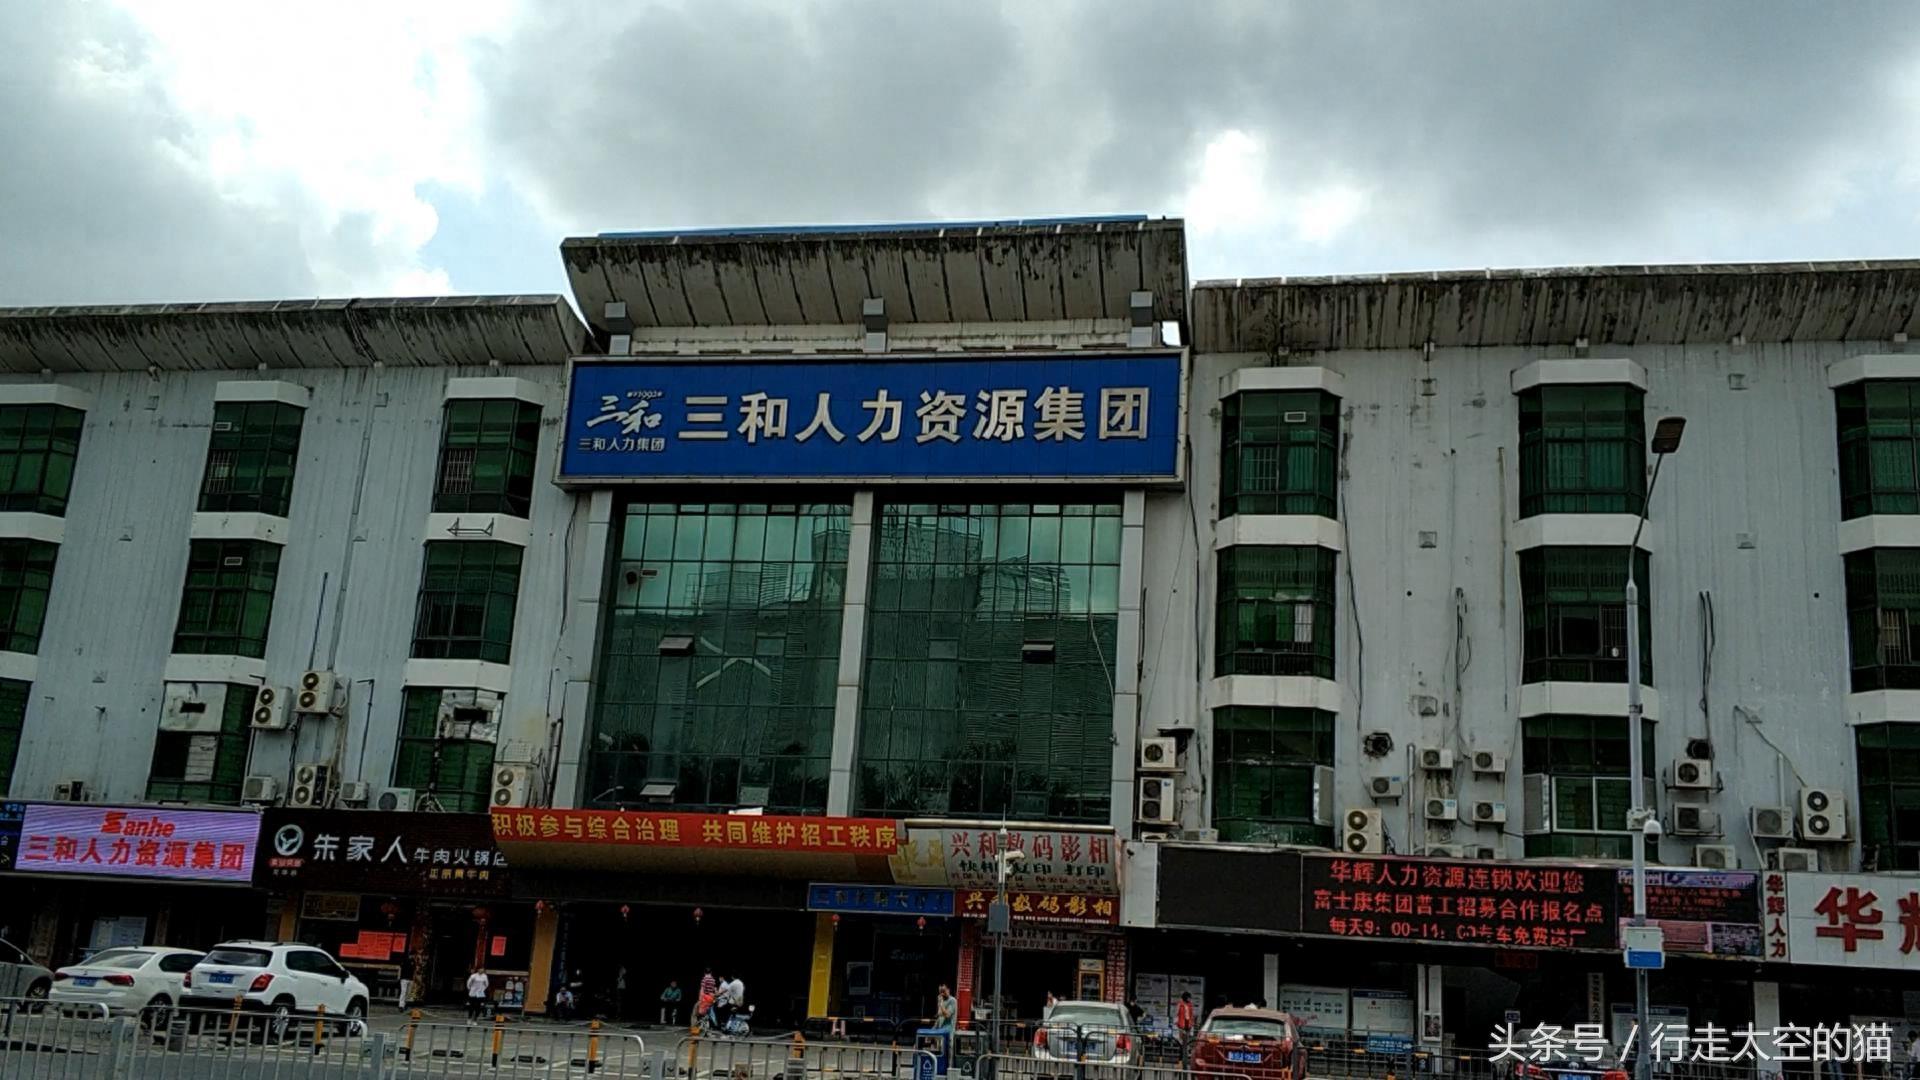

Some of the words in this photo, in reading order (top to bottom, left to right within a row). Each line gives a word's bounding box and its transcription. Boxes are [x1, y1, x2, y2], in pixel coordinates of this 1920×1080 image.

[586, 395, 662, 435] 三和
[679, 386, 1150, 444] 三和人力资源集团
[578, 437, 665, 452] 三和人力集团
[101, 811, 175, 837] Sanhe
[491, 812, 681, 842] 积极参与综合治理
[702, 820, 897, 849] 共同维护招工秩序
[24, 835, 246, 871] 三和人力资源集团
[313, 834, 407, 863] 朱家人
[1330, 860, 1584, 893] 华辉人力资源连锁欢迎您
[1766, 874, 1786, 957] 华辉人力
